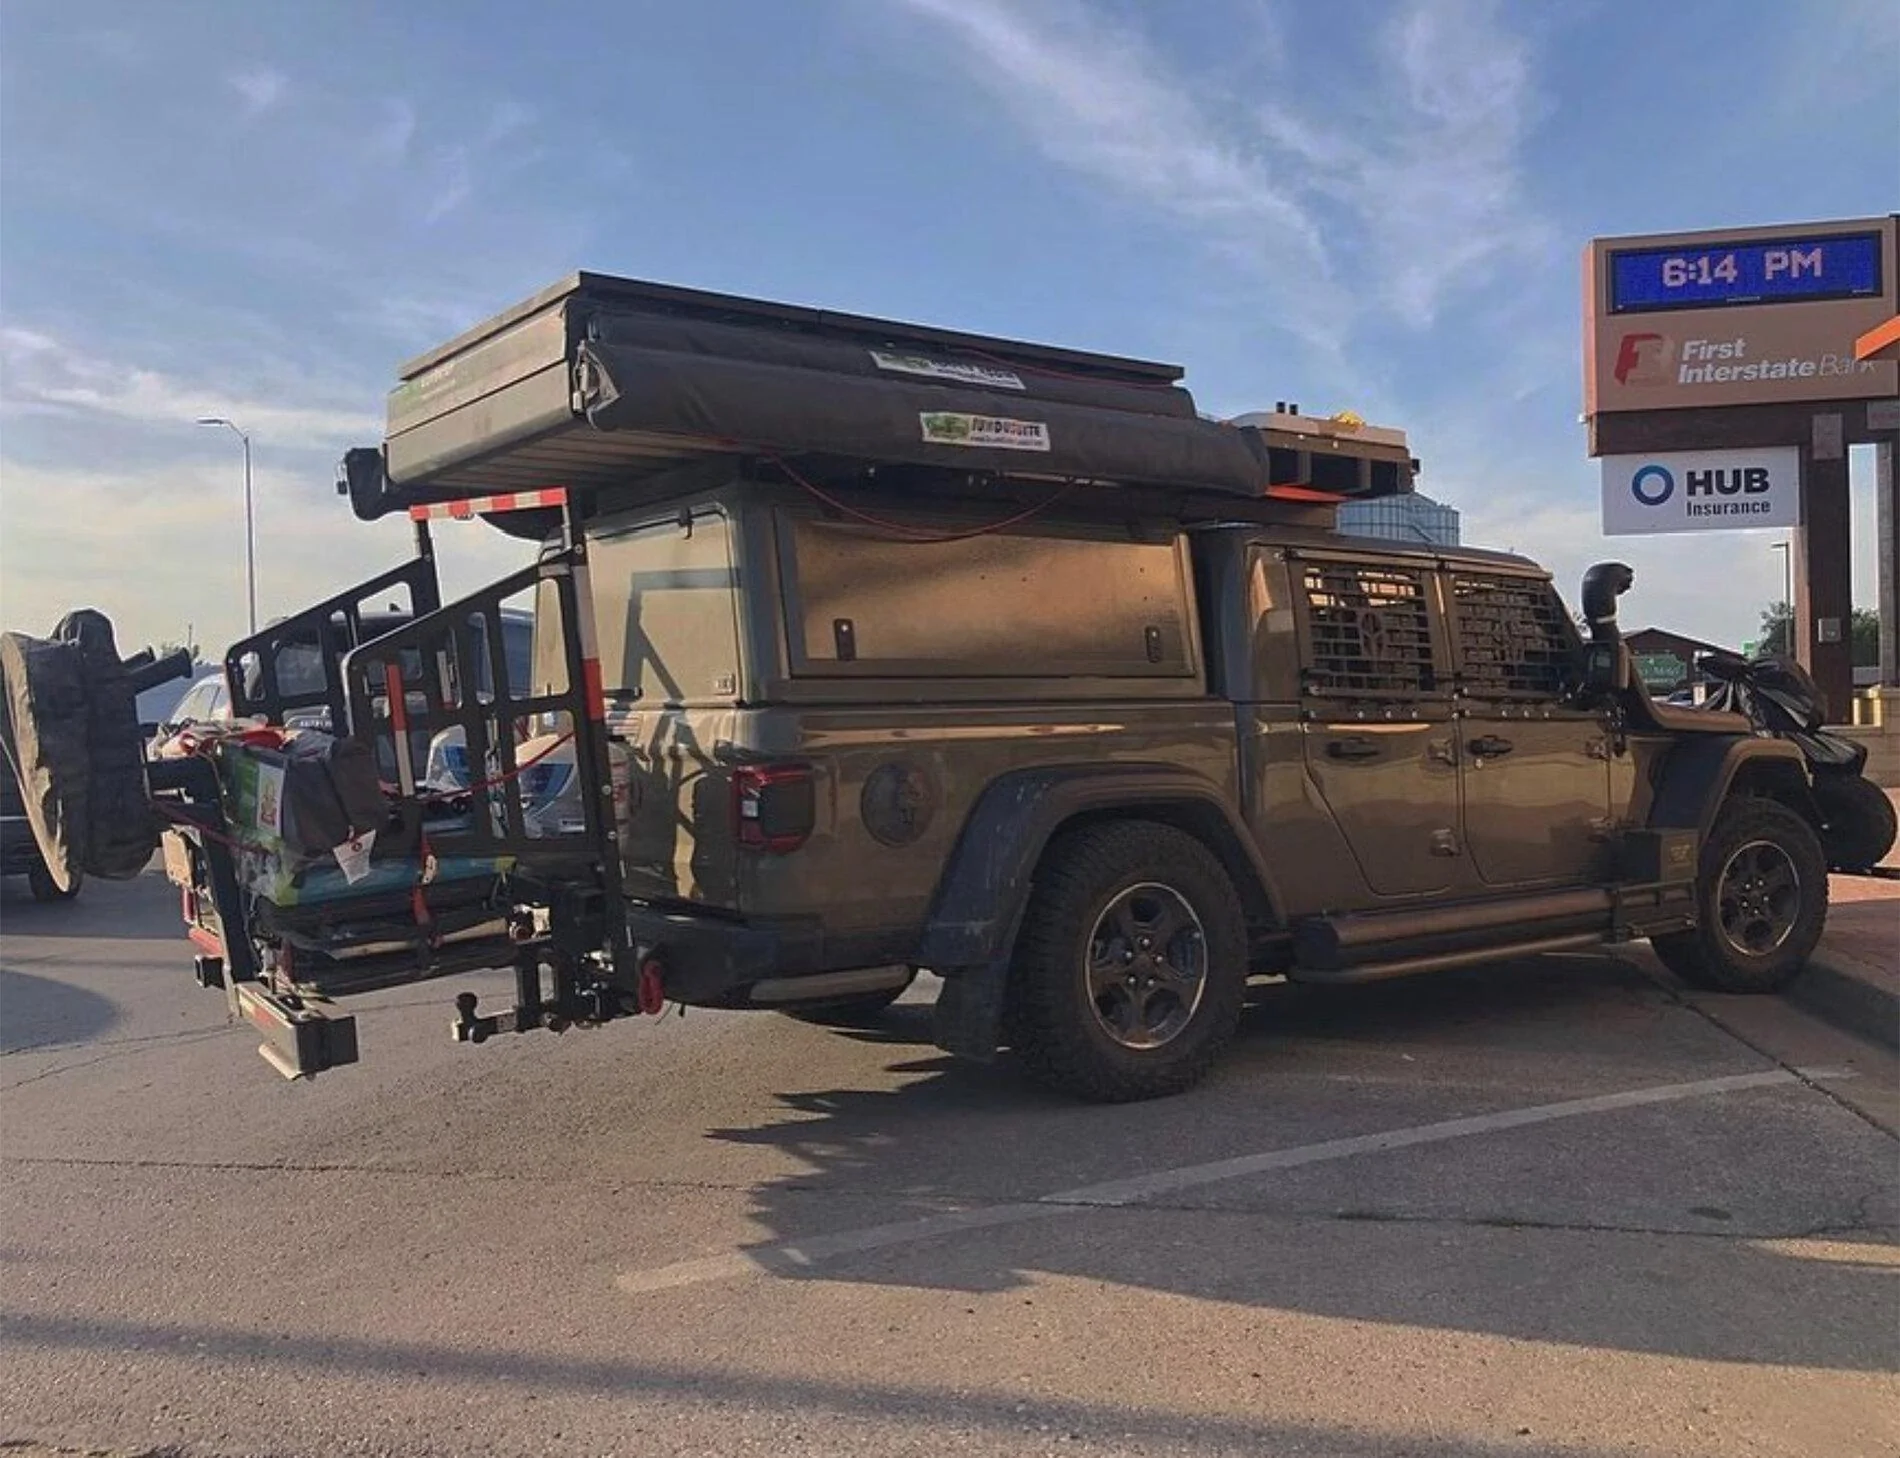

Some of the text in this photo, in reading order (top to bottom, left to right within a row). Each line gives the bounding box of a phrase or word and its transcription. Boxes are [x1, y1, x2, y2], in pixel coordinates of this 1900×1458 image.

[1662, 248, 1822, 287] 6:14 PM
[1682, 338, 1746, 361] First
[1678, 357, 1817, 384] Interstate
[1686, 467, 1770, 496] HUB
[1686, 501, 1772, 517] Insurance
